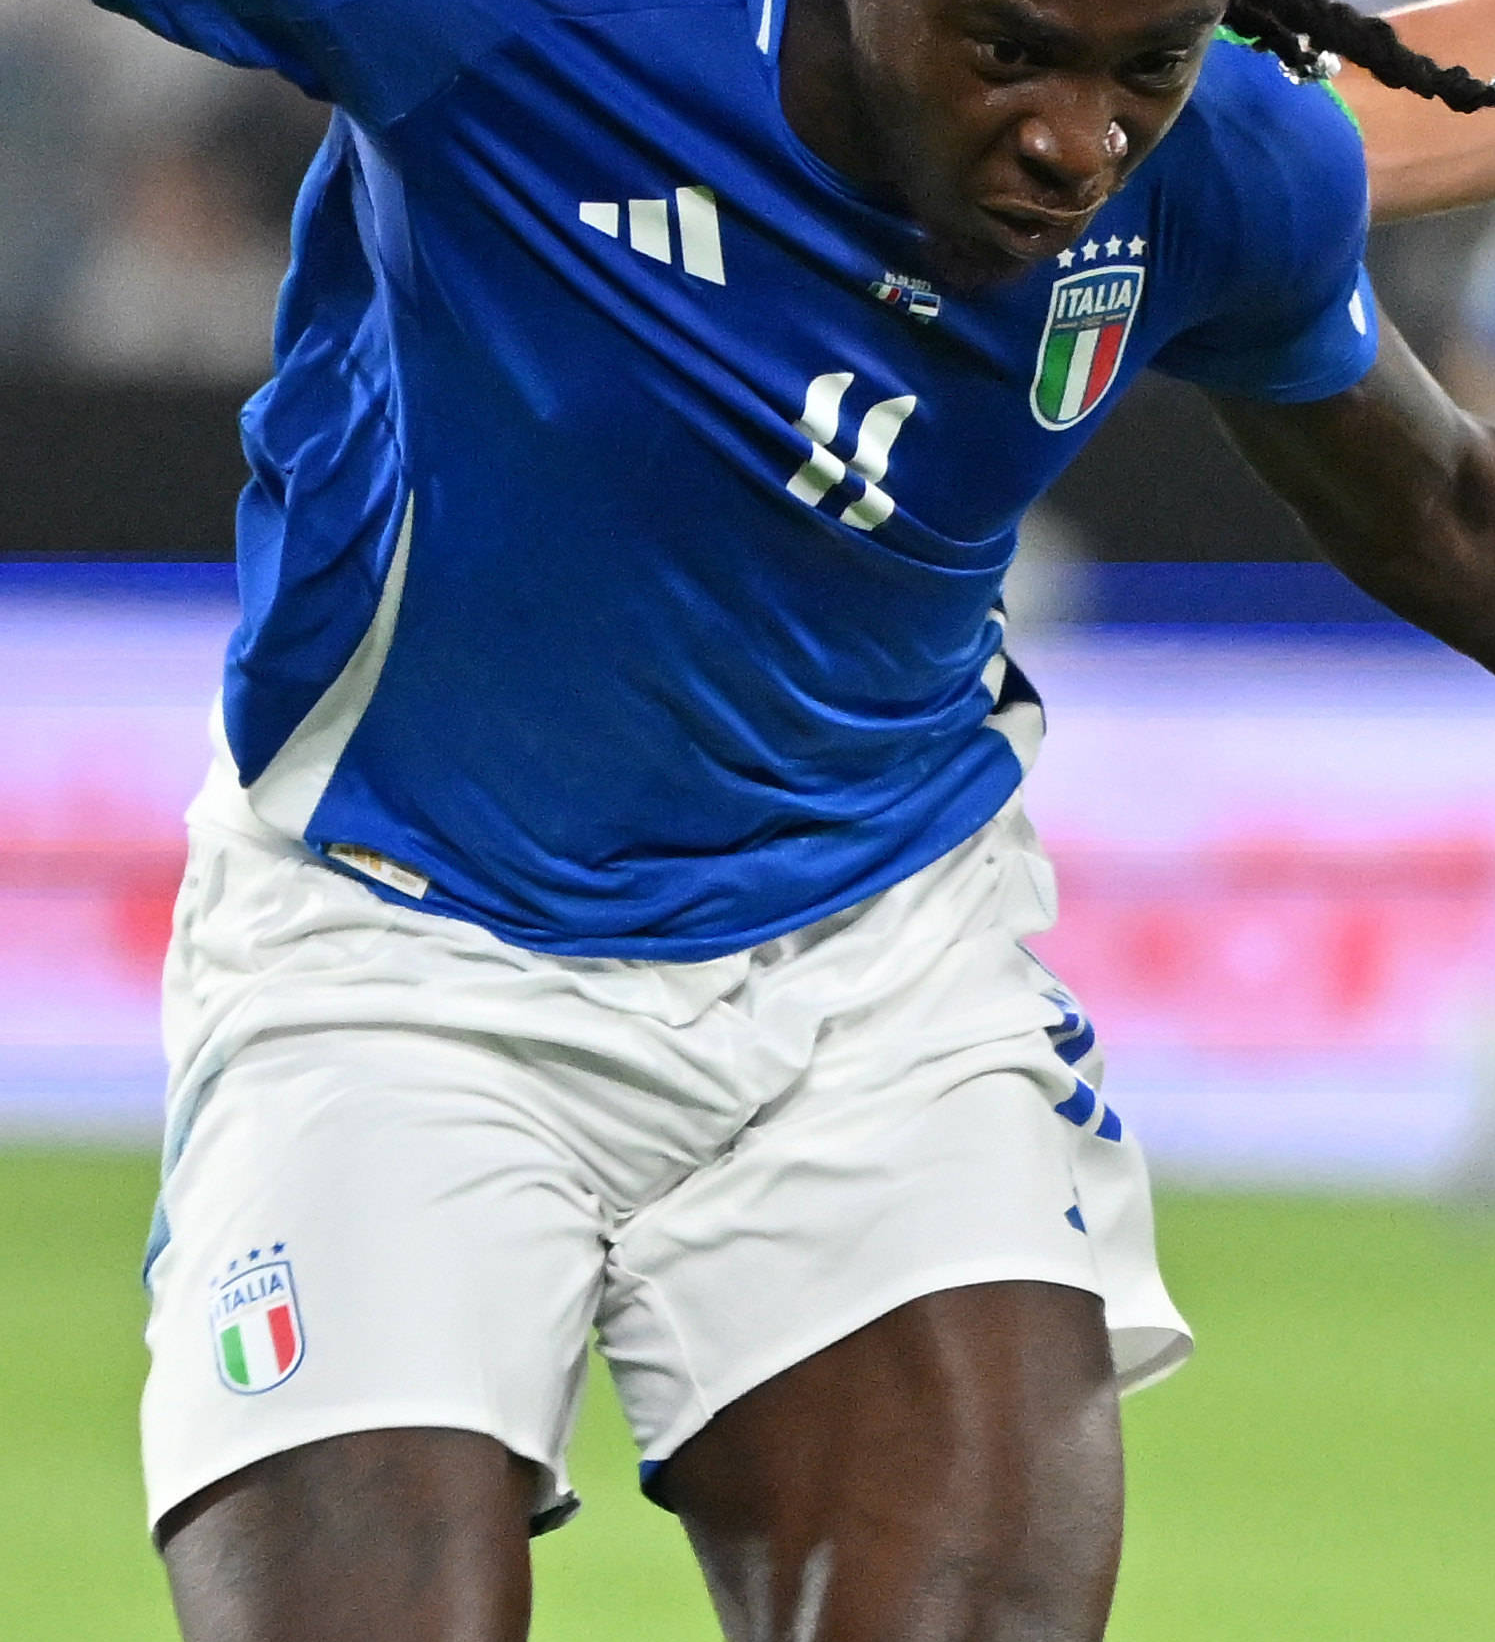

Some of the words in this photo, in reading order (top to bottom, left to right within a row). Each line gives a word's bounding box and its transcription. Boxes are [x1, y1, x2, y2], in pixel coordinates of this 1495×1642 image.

[1056, 279, 1133, 319] ITALIA
[785, 371, 917, 531] 11
[213, 1271, 285, 1319] ITALIA
